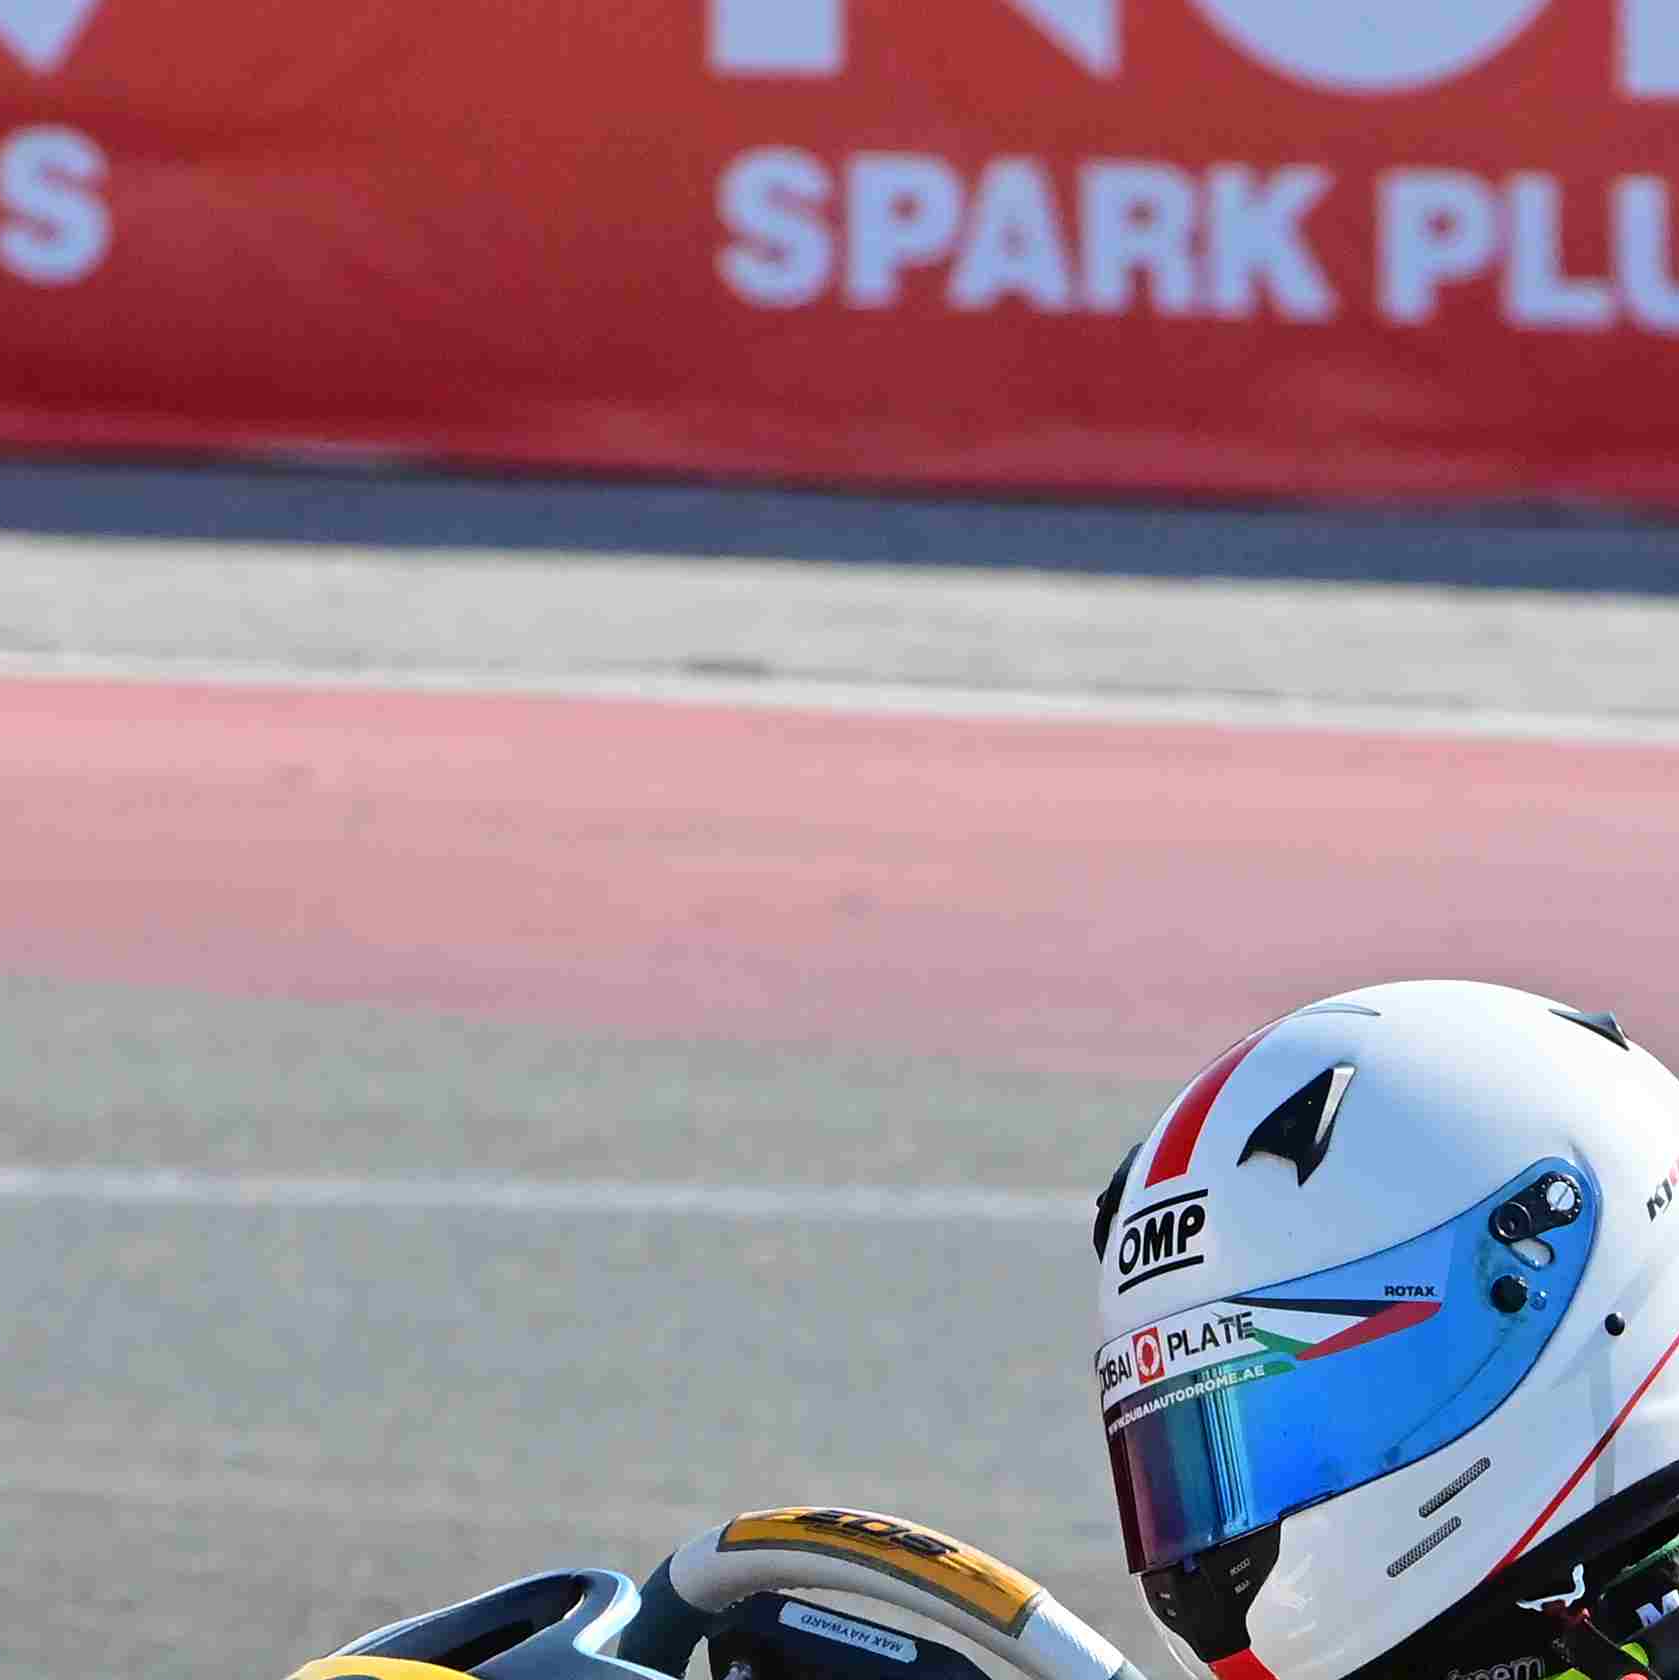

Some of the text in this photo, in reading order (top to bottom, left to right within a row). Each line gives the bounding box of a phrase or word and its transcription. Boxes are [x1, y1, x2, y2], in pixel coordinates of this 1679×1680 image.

[717, 148, 1335, 322] SPARK
[1119, 1204, 1206, 1276] OMP
[1384, 1285, 1436, 1297] ROTAX
[1166, 1311, 1256, 1362] PLATE
